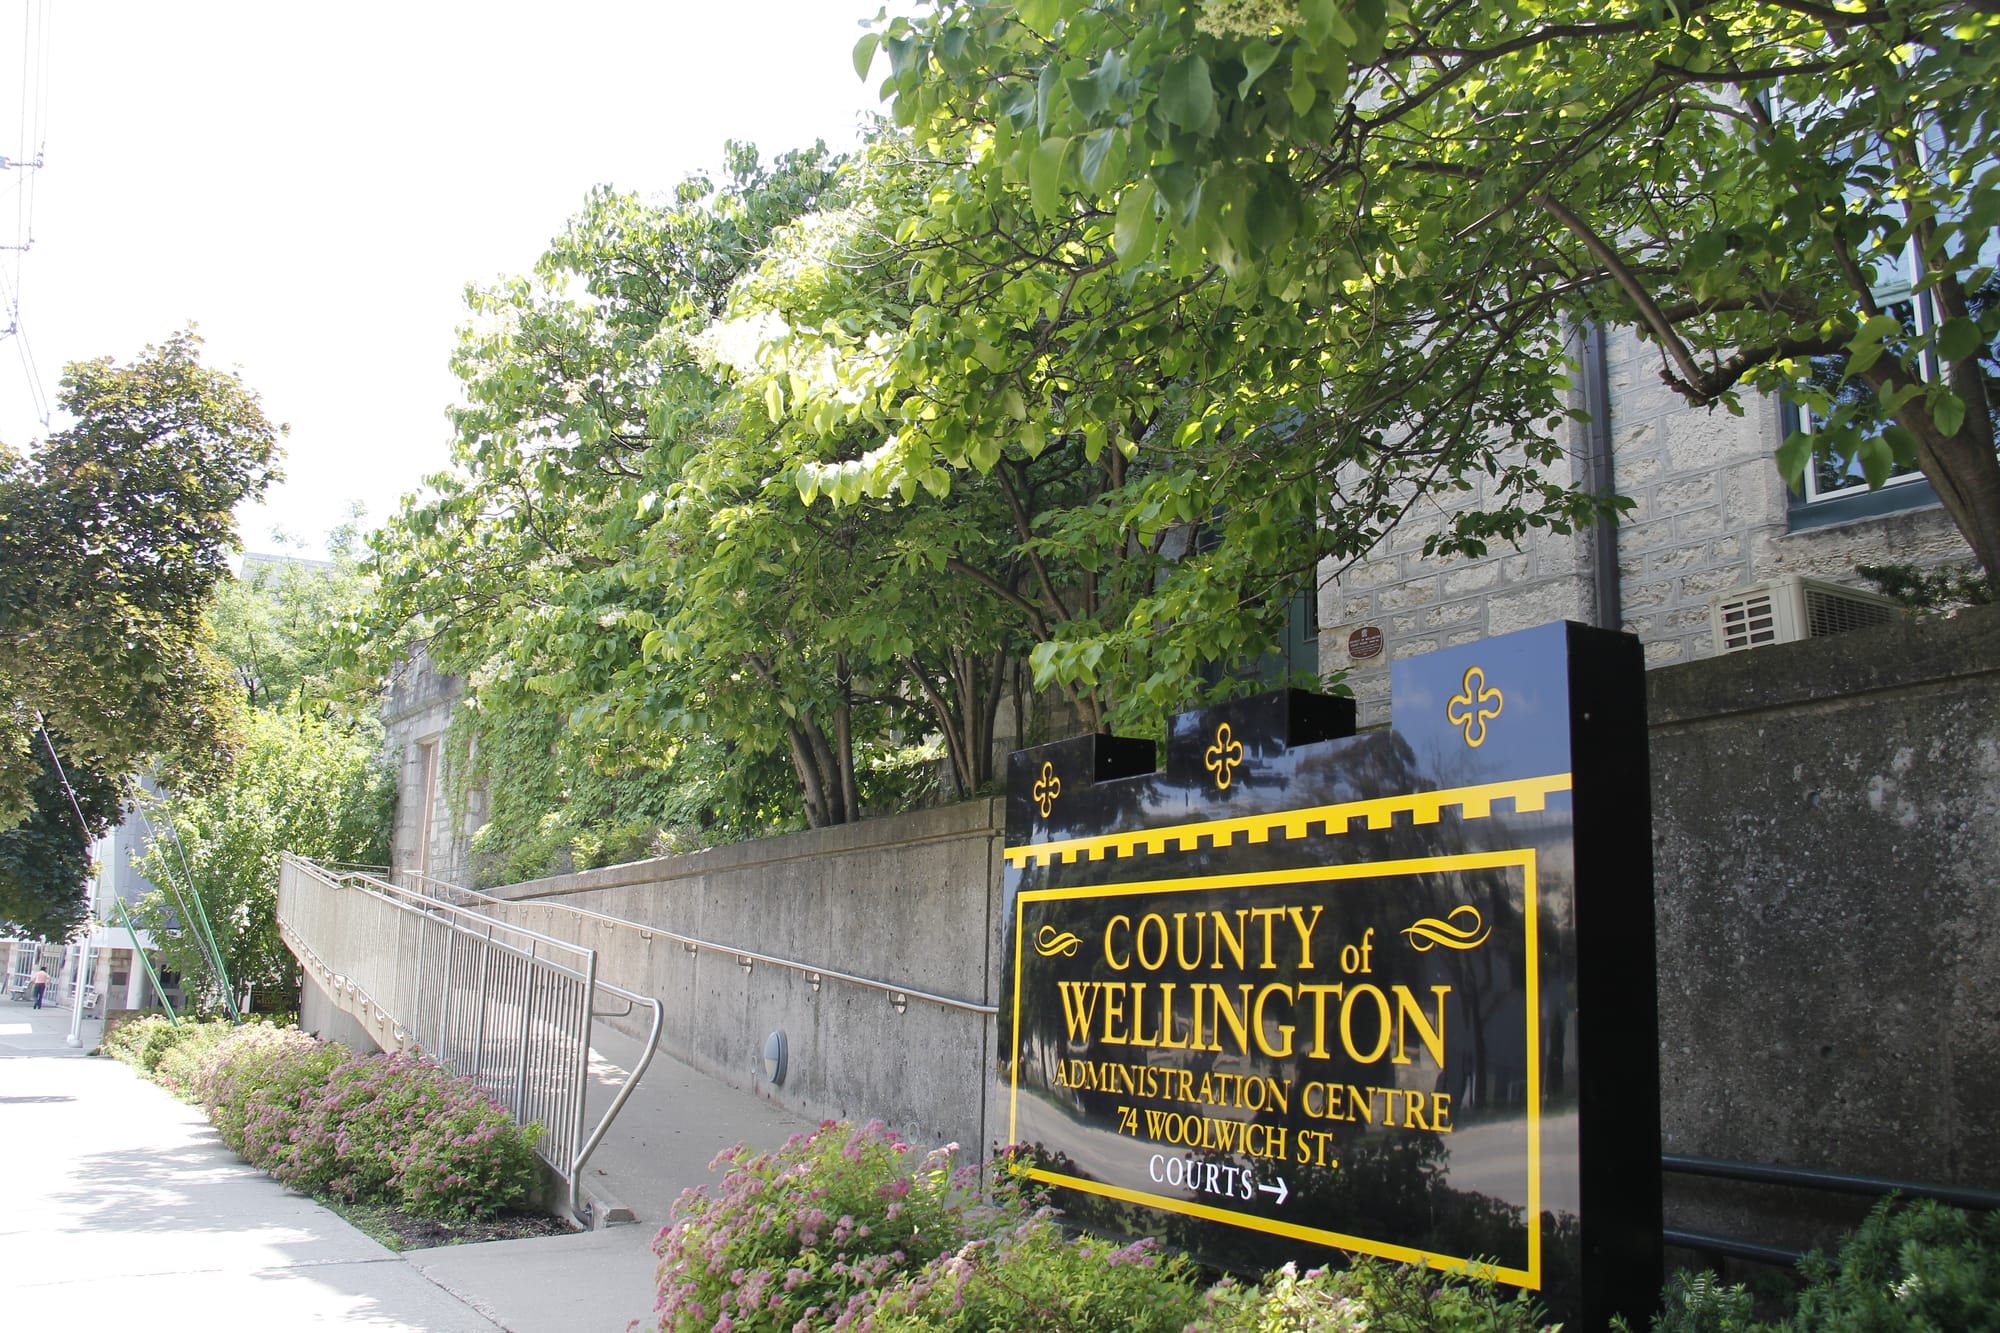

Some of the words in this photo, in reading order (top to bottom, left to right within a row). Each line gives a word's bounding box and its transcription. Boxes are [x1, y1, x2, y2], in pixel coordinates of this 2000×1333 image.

[1104, 906, 1323, 971] COUNTY
[1340, 927, 1374, 974] of
[1057, 981, 1452, 1069] WELLINGTON
[1054, 1059, 1291, 1115] ADMINISTRATION
[1301, 1081, 1453, 1132] CENTRE
[1116, 1105, 1138, 1135] 74
[1144, 1109, 1288, 1161] WOOLWICH
[1296, 1131, 1339, 1169] ST.
[1149, 1154, 1253, 1200] COURTS
